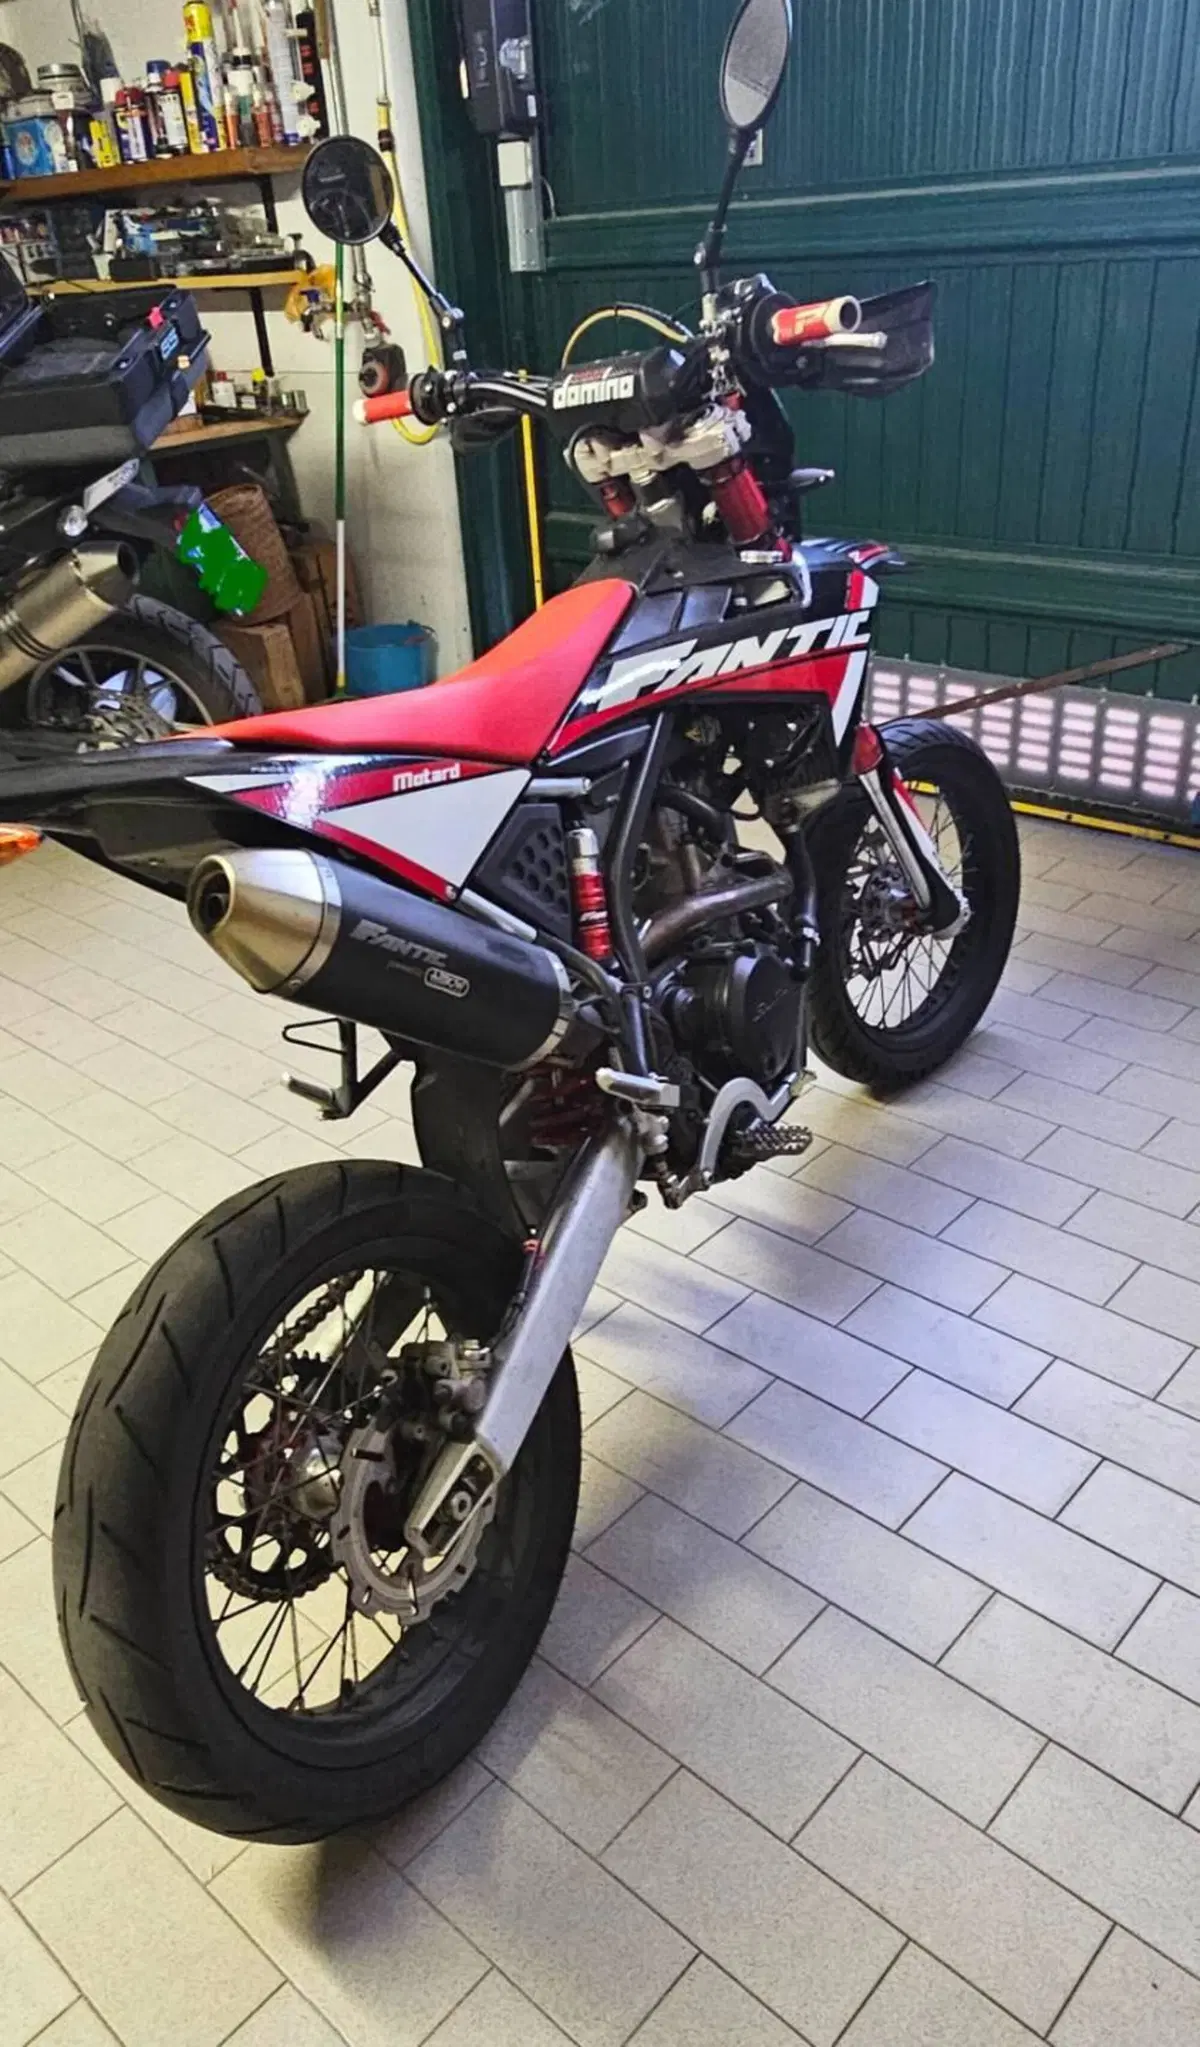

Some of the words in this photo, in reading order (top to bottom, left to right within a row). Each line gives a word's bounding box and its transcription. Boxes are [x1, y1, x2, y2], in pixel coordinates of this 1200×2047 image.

[553, 367, 635, 410] domino
[583, 610, 871, 713] FANTIC
[393, 762, 461, 792] Motard
[349, 918, 448, 968] FANTIC
